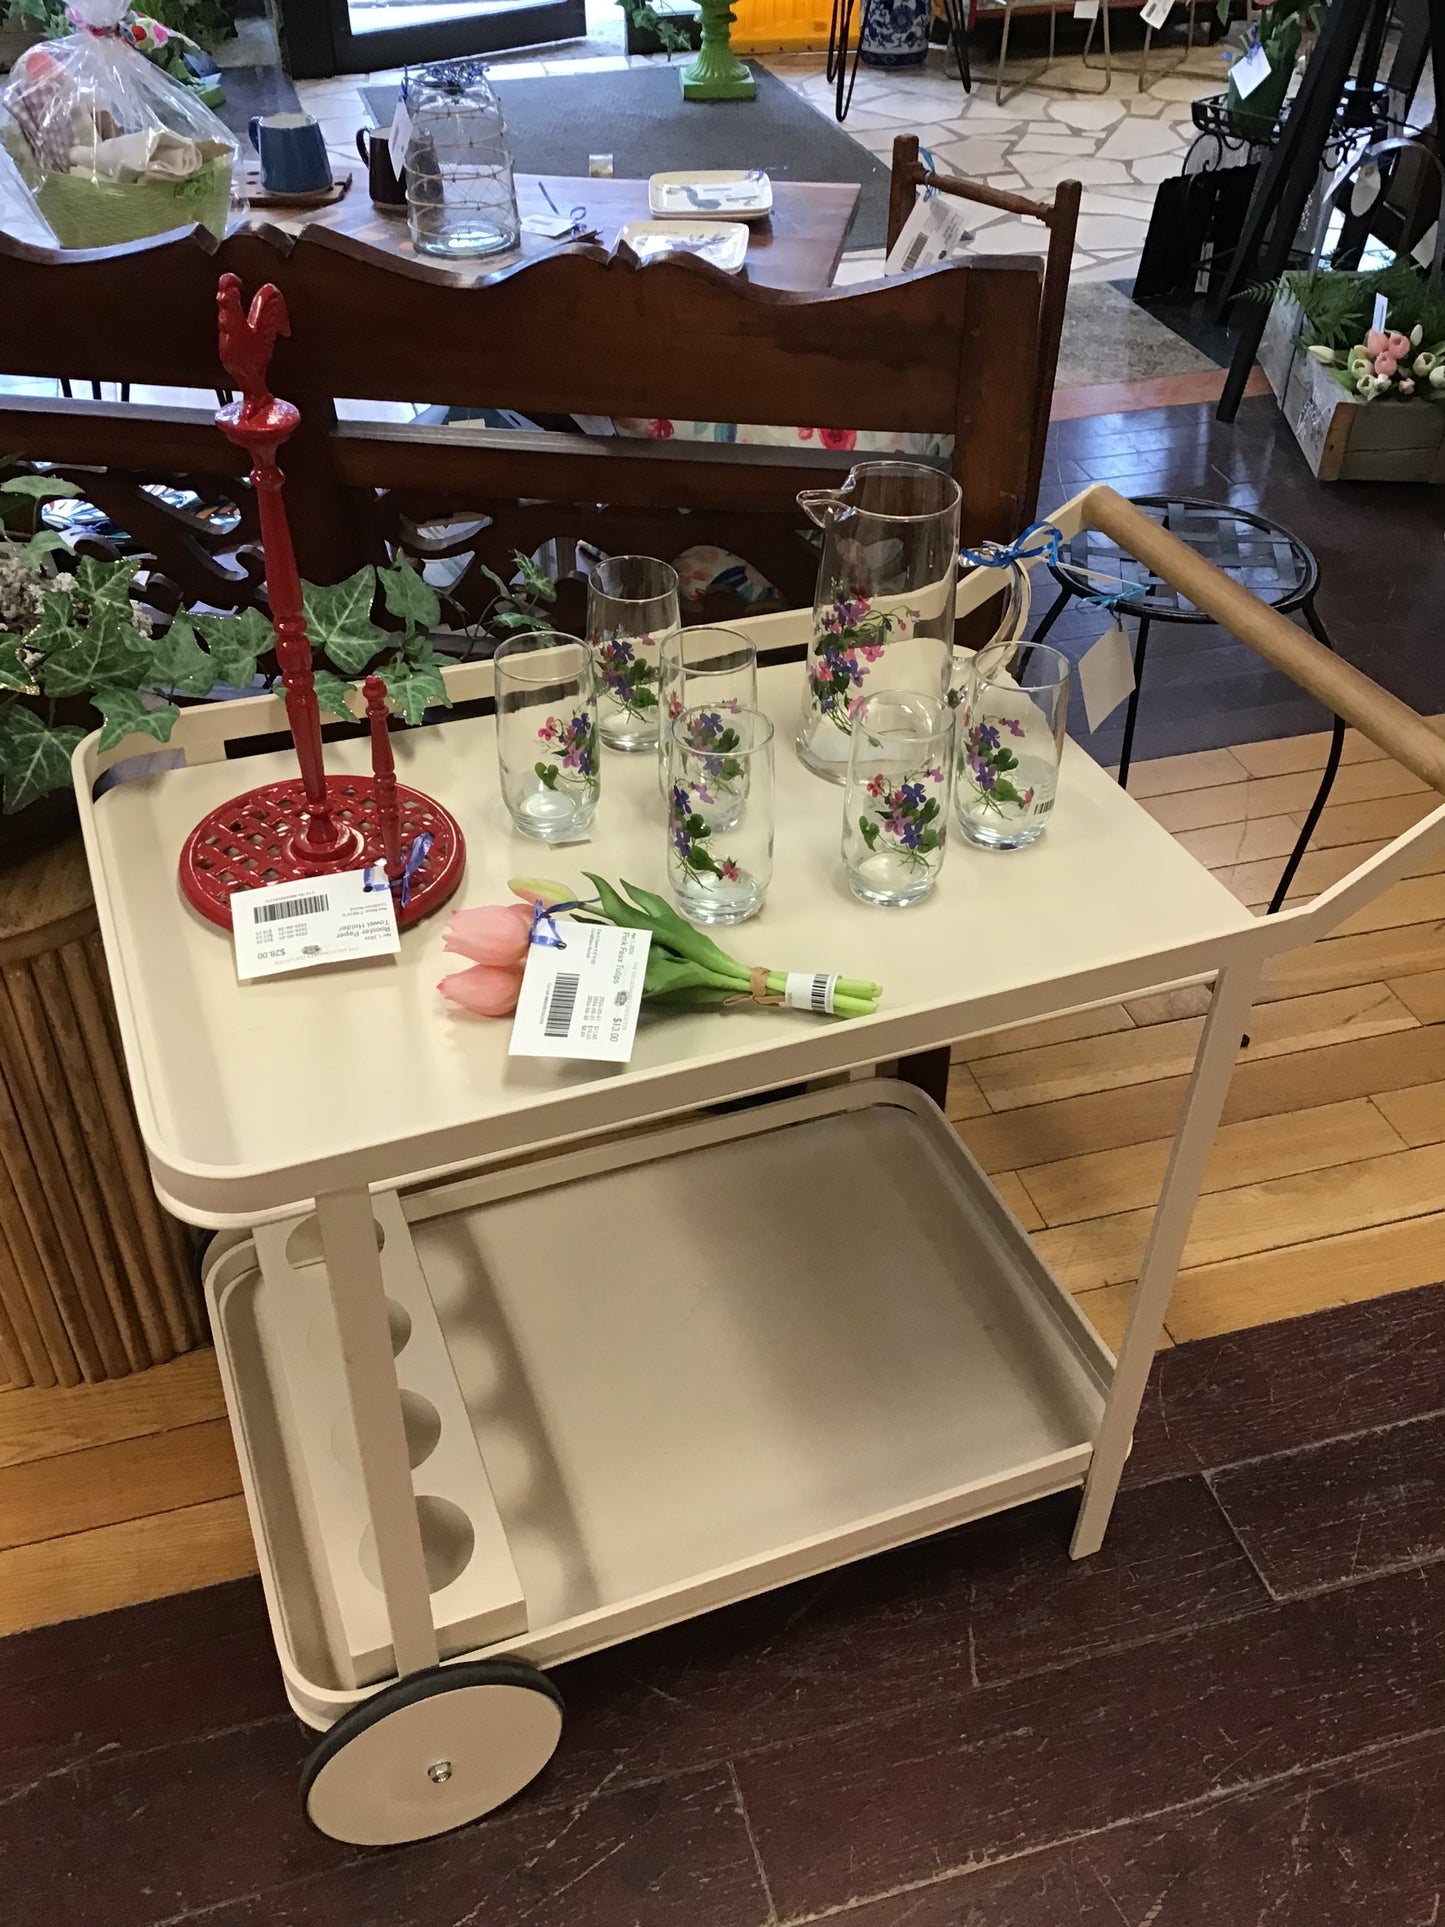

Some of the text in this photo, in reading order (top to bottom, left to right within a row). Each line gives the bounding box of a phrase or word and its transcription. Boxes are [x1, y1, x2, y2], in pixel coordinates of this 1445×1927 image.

[336, 925, 390, 940] Rooster Paper
[339, 919, 389, 933] Towel Holder
[257, 948, 286, 960] $28.00
[612, 932, 630, 984] Pink Faux Tulips
[609, 1017, 622, 1042] $13.00
